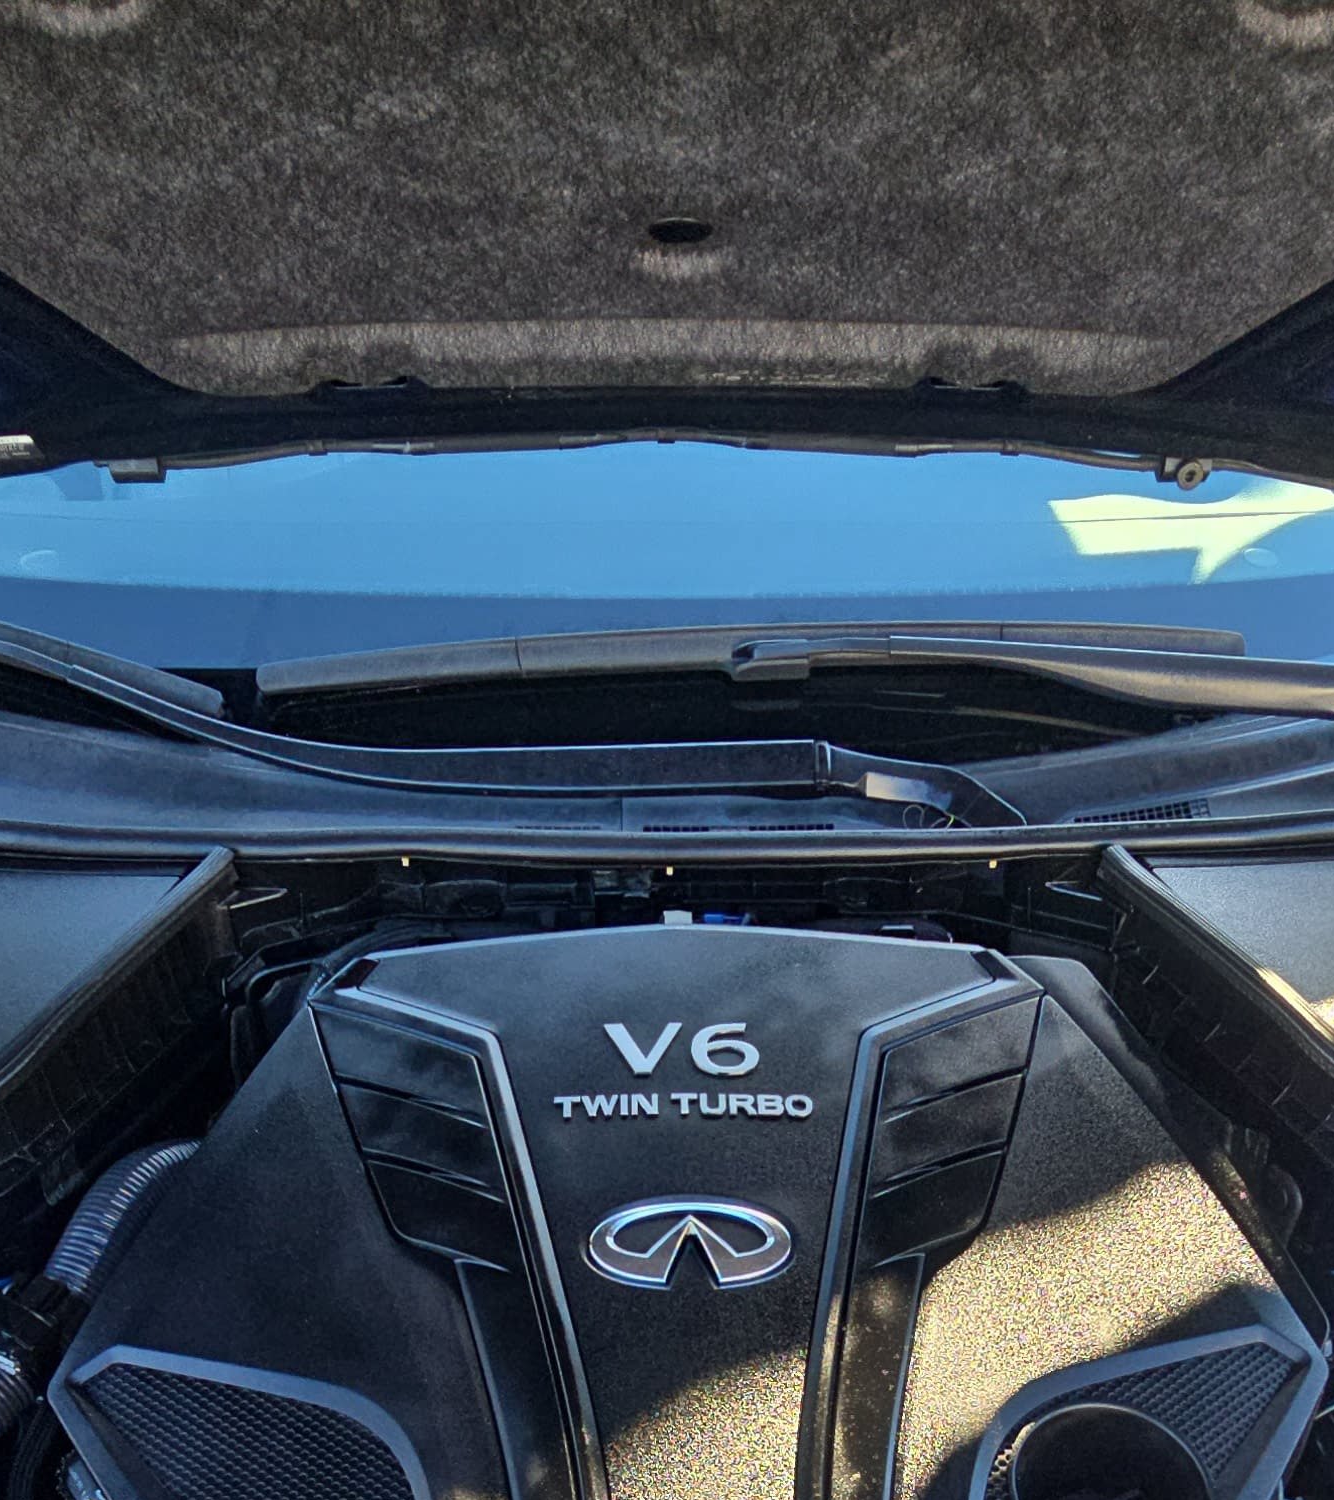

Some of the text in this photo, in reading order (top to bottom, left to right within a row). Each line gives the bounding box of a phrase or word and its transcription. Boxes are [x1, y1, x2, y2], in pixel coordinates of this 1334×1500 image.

[603, 1022, 760, 1077] V6
[553, 1092, 813, 1119] TWIN TURBO
